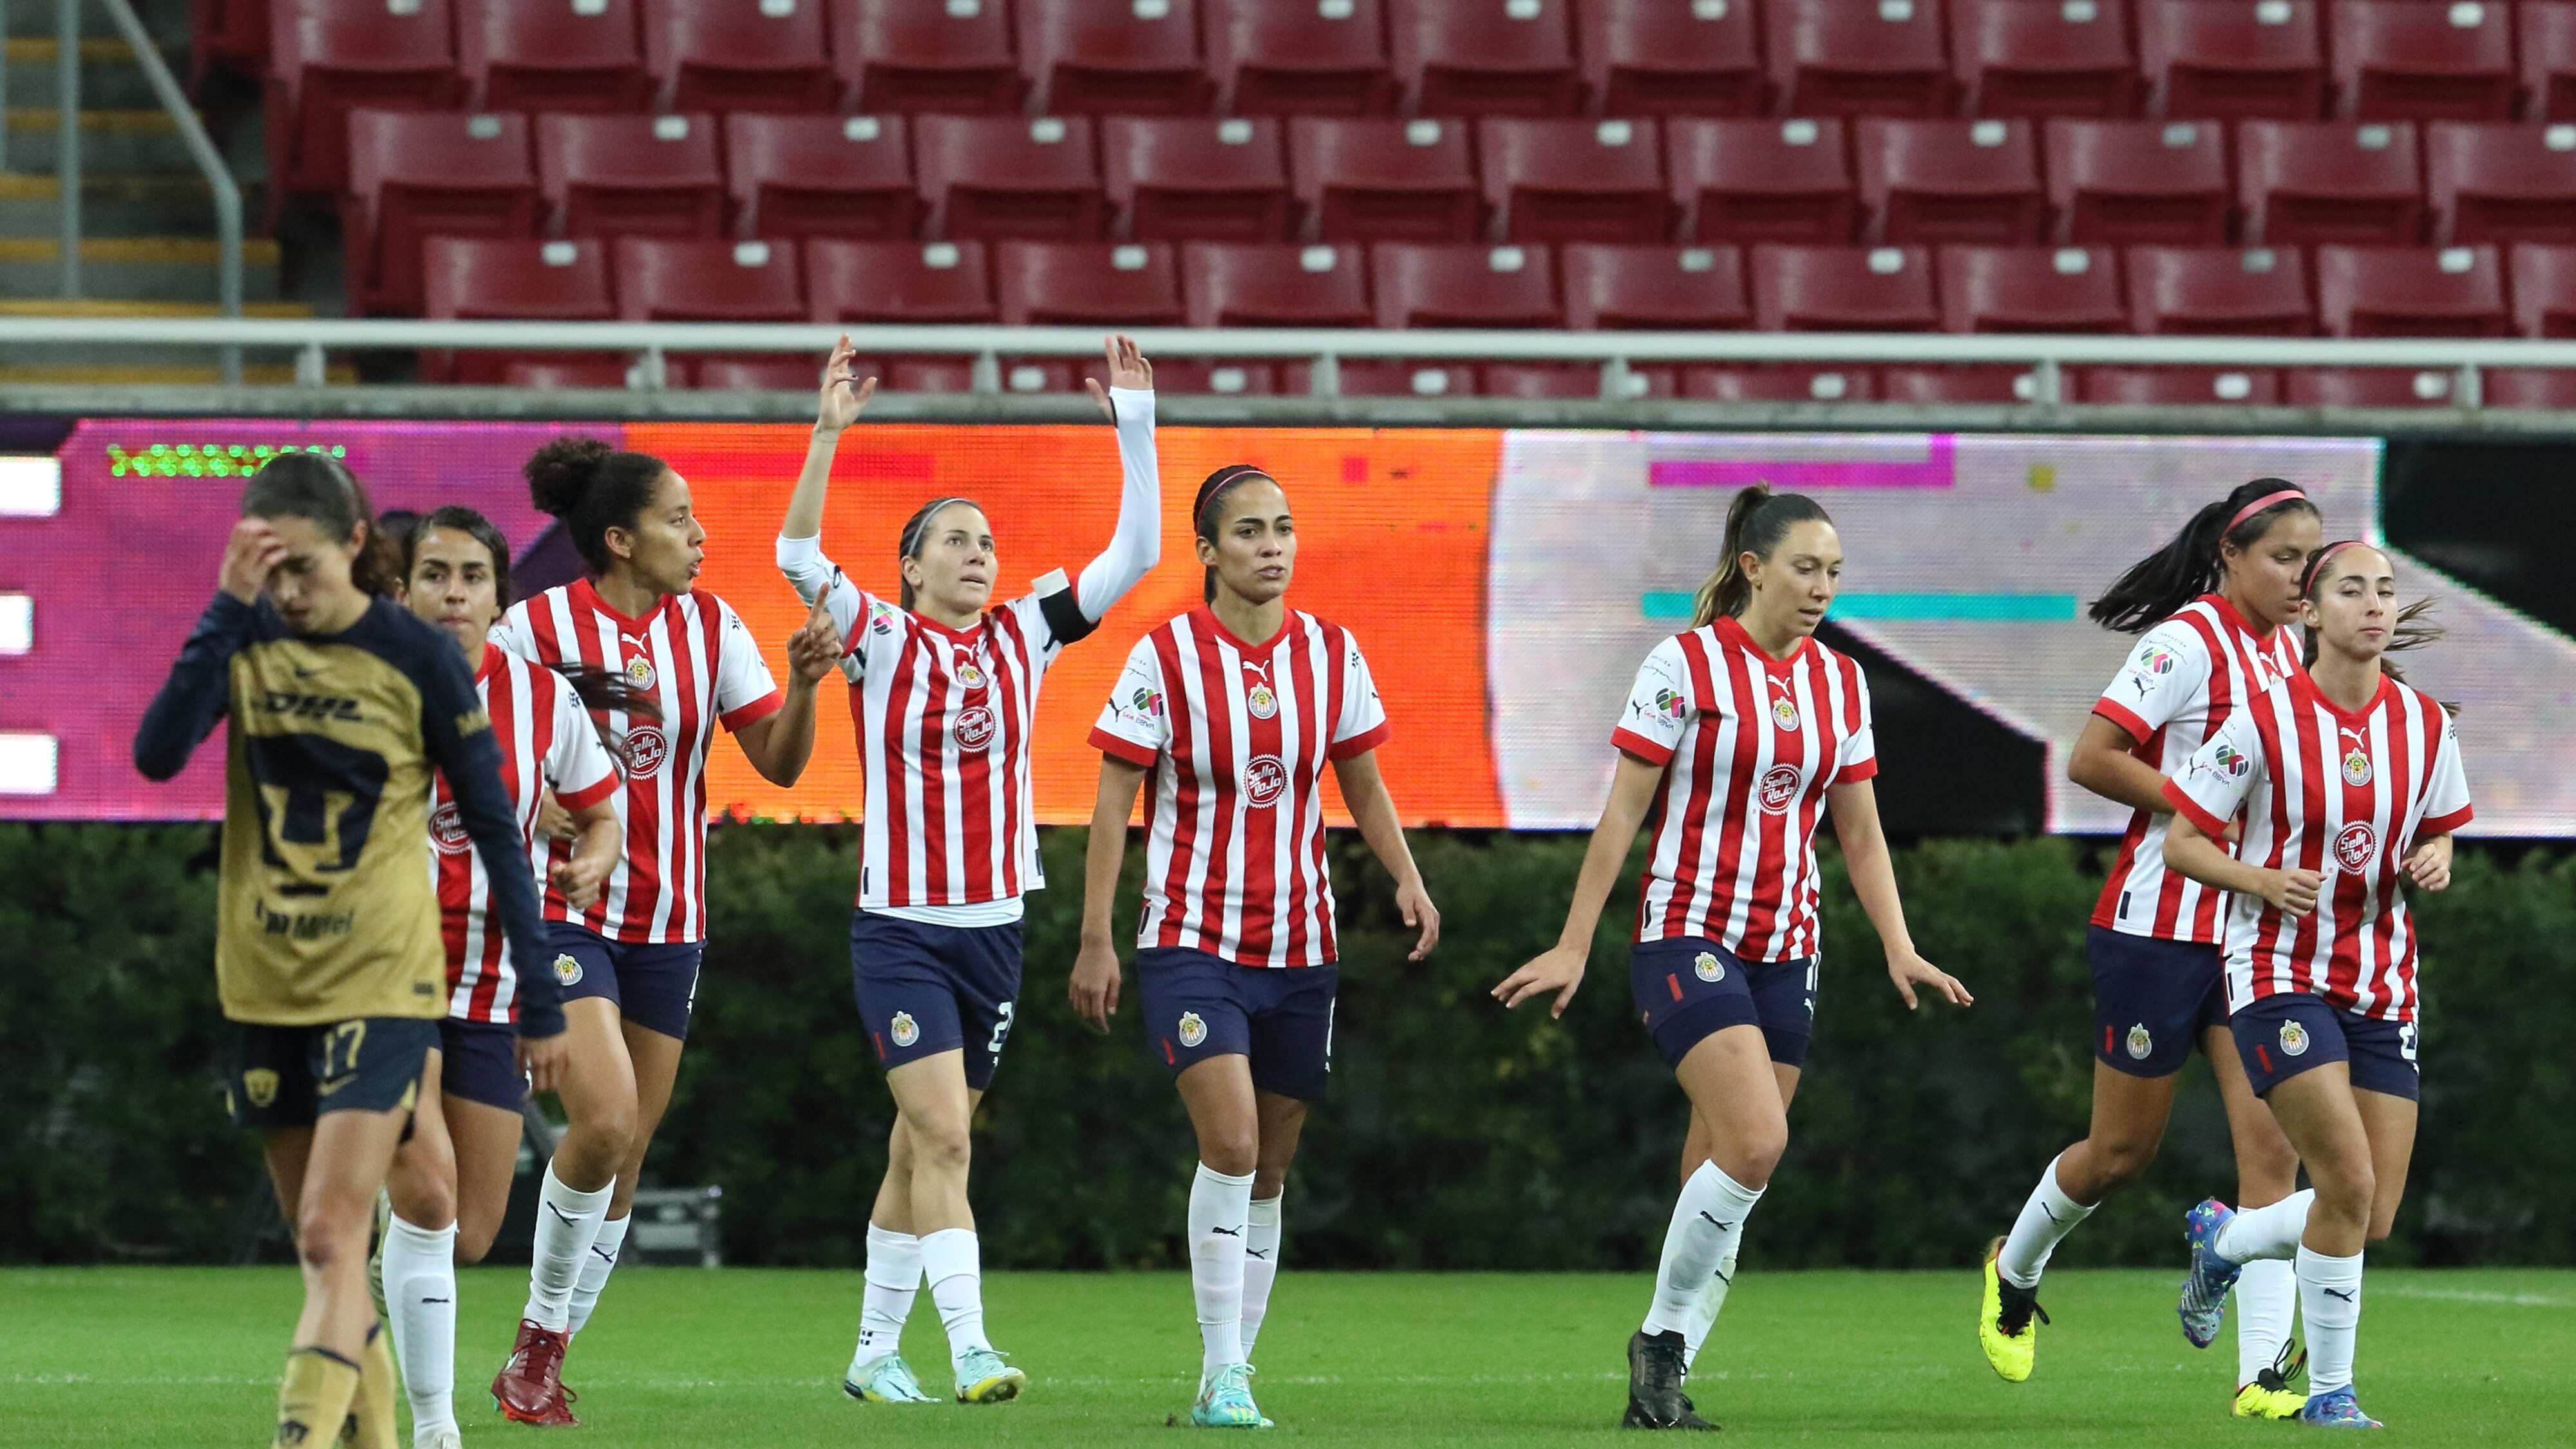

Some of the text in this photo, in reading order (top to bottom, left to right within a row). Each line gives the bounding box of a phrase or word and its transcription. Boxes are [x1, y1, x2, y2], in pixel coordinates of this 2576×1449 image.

[265, 691, 362, 721] DHL
[959, 712, 986, 732] Sello
[1248, 764, 1276, 786] Sello
[1765, 773, 1793, 790] Sello
[2340, 831, 2366, 850] Sello
[988, 1001, 1014, 1052] 2
[323, 1020, 366, 1077] 17
